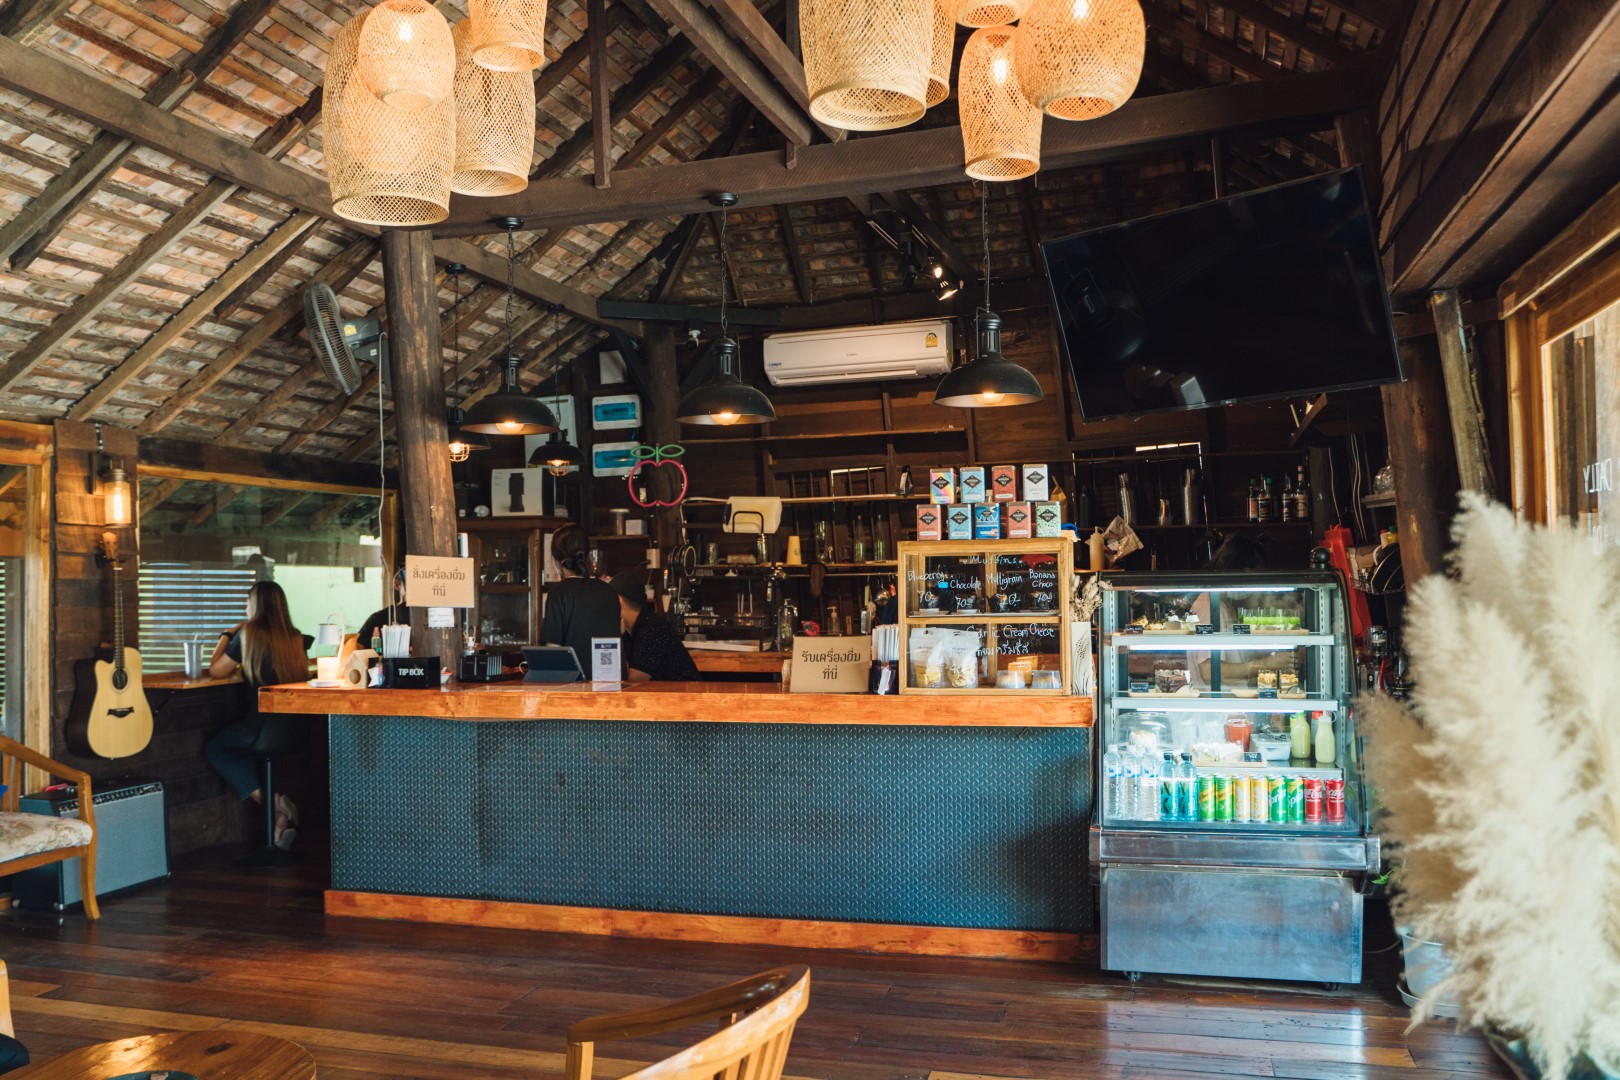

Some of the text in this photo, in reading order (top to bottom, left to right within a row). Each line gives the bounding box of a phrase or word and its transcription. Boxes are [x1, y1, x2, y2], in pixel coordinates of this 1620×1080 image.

[412, 564, 466, 581] สั่งเครื่องดื่ม
[1028, 568, 1056, 579] Banana
[432, 582, 446, 596] ที่นี่
[949, 575, 983, 590] Chocolate
[1031, 579, 1053, 588] Choco
[1003, 624, 1029, 638] Cream
[801, 647, 861, 663] รับเครื่องดื่ม
[398, 668, 424, 676] TIP BOX
[822, 664, 838, 680] ที่นี่
